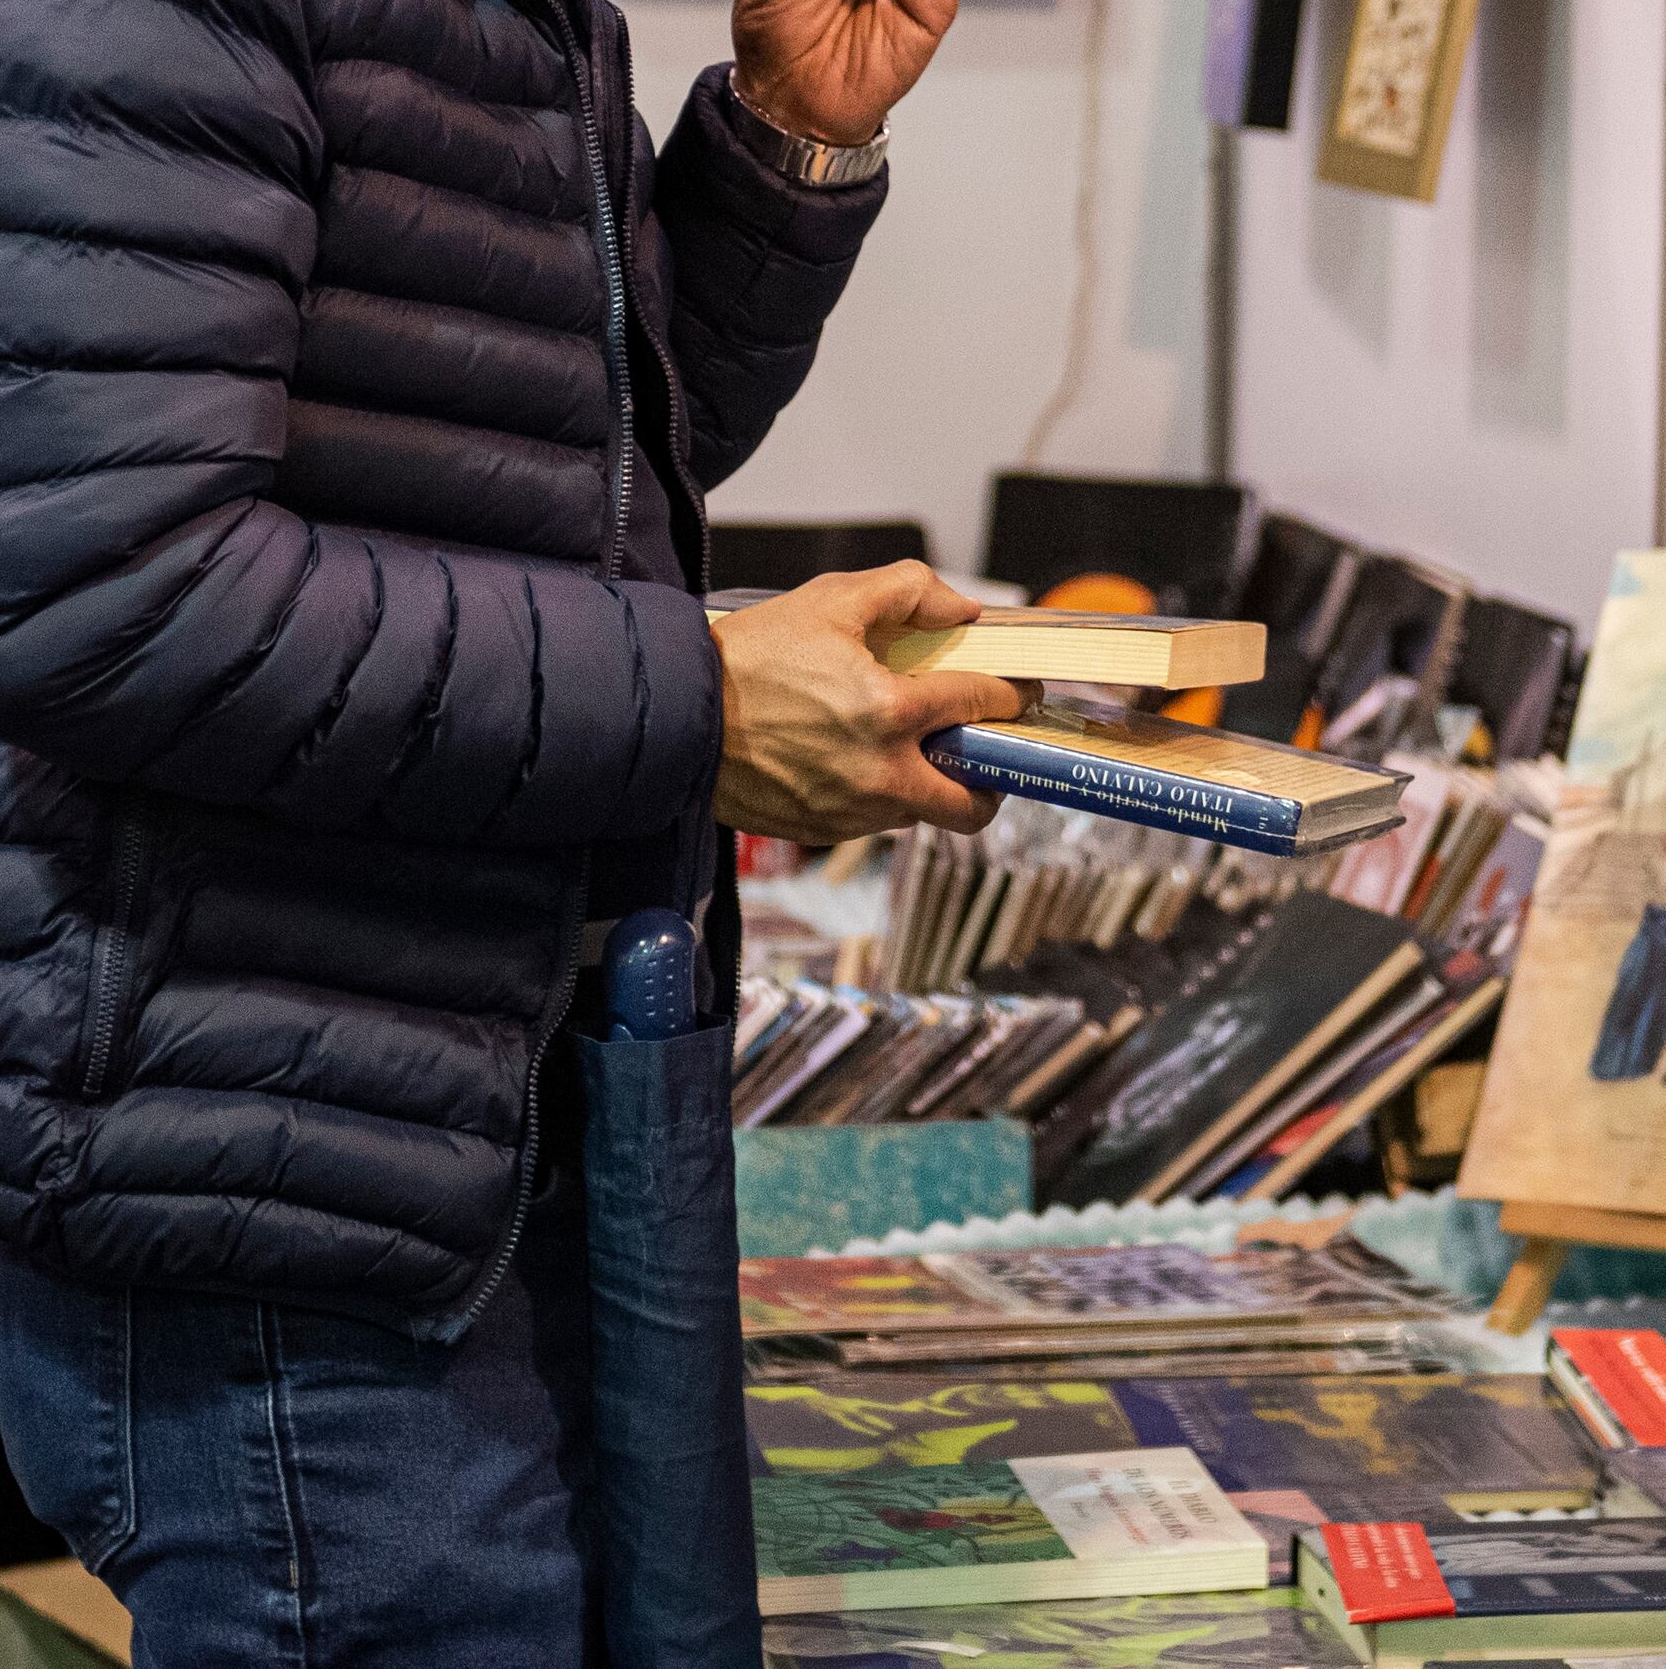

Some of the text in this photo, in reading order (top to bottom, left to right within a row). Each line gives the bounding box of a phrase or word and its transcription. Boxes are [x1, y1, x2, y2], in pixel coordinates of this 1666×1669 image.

[927, 752, 1230, 834] Mundo escrito y mundo no escri
[1071, 762, 1233, 814] ITALO CALVINO
